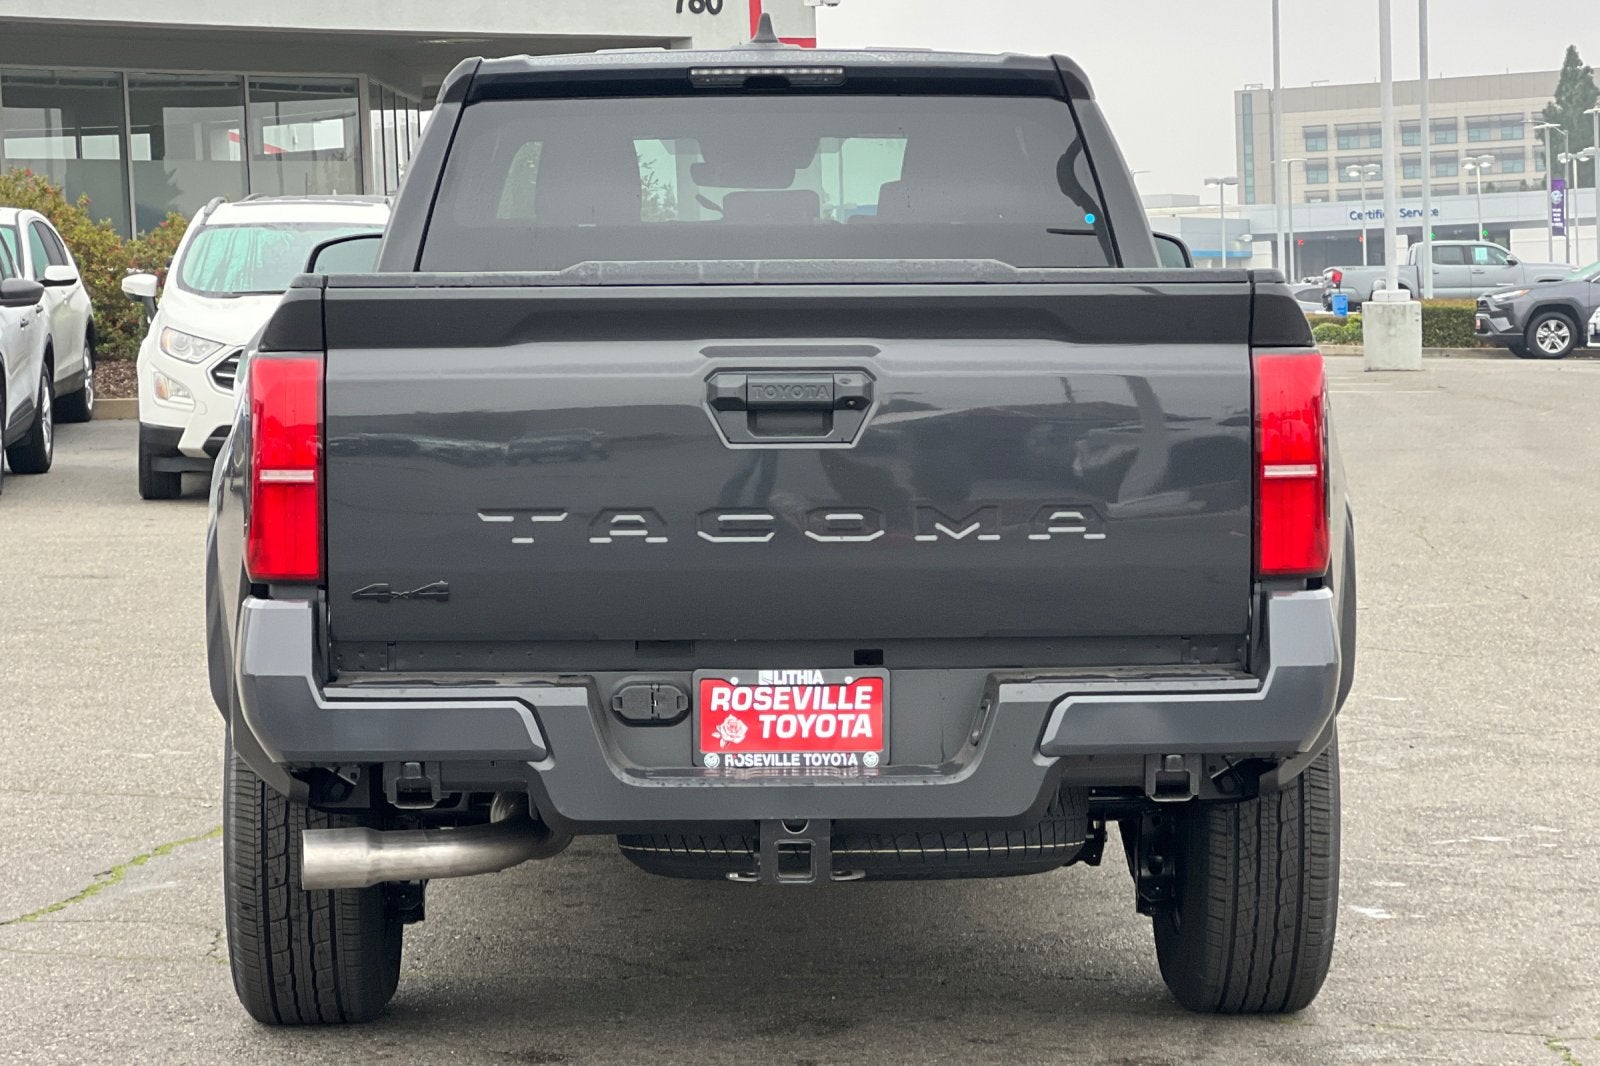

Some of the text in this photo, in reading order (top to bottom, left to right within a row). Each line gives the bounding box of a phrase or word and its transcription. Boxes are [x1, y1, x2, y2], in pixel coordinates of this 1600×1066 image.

[751, 384, 831, 400] TOYOTA
[476, 505, 1107, 545] TACOMA
[773, 669, 825, 685] LITHIA
[710, 685, 873, 712] ROSEVILLE
[758, 713, 873, 739] TOYOTA
[724, 752, 859, 767] ROSEVILLE TOYOTA
